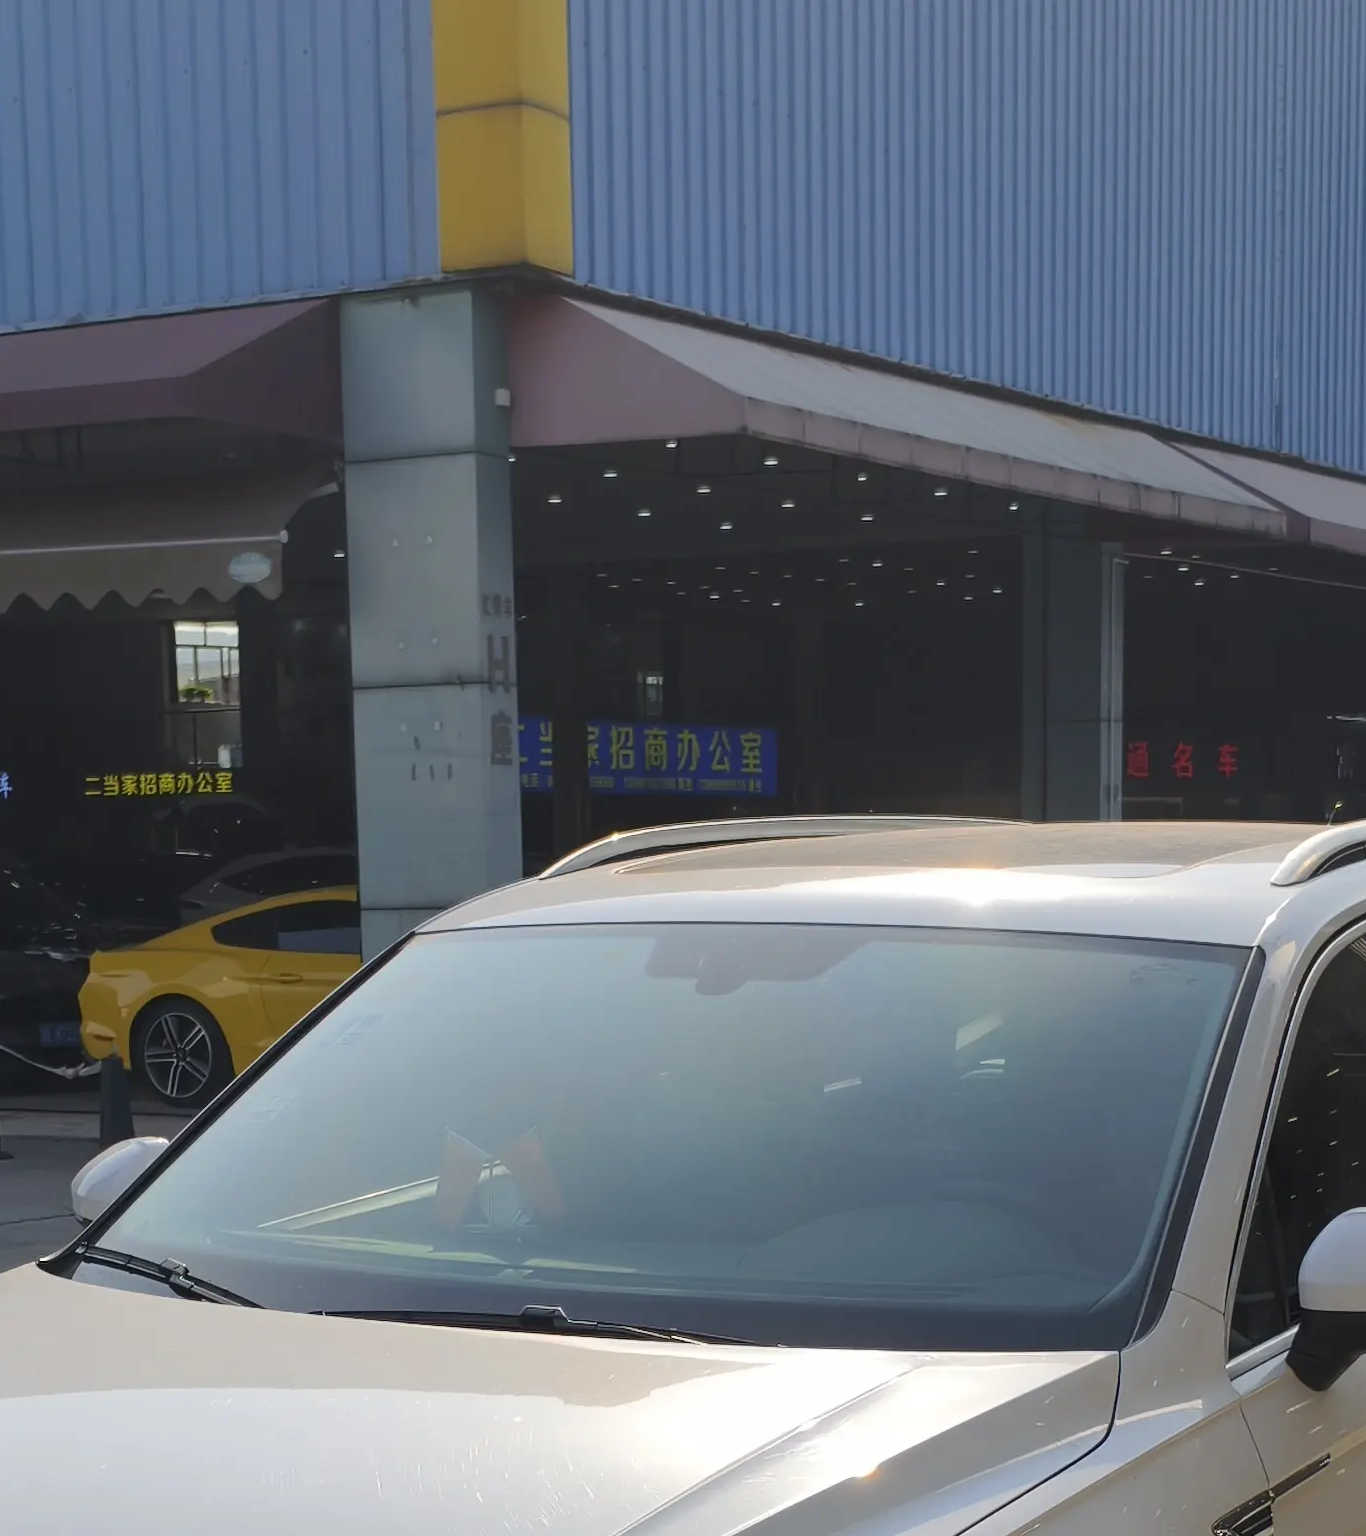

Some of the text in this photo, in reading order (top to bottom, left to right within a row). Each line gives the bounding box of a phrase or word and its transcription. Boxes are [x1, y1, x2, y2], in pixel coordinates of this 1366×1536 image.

[84, 771, 233, 796] 二当家招商办公室
